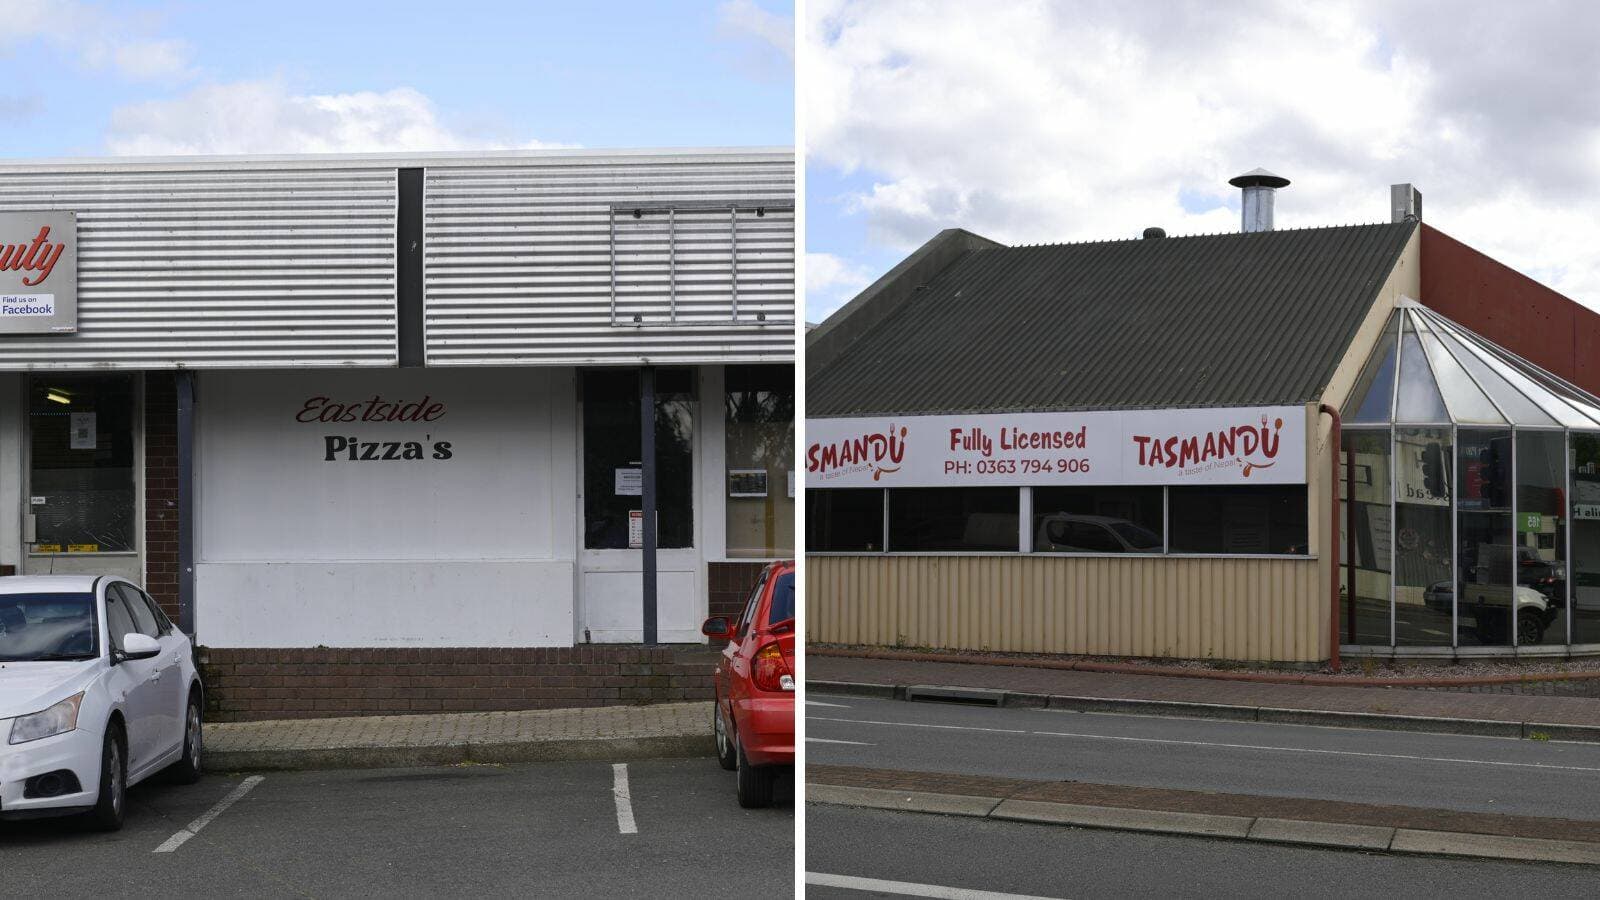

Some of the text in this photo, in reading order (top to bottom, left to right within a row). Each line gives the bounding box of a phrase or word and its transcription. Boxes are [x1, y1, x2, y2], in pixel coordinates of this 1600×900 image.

[0, 226, 65, 287] uty
[2, 304, 52, 314] Facebook
[296, 395, 447, 423] Eastside
[324, 434, 453, 462] Pizza's
[950, 426, 1087, 456] Fully Licensed
[1133, 423, 1280, 469] TASMANDU
[944, 459, 1091, 475] PH: 0363 794 906
[1184, 466, 1203, 476] taste
[1204, 462, 1213, 472] of
[1213, 460, 1236, 470] Nepal
